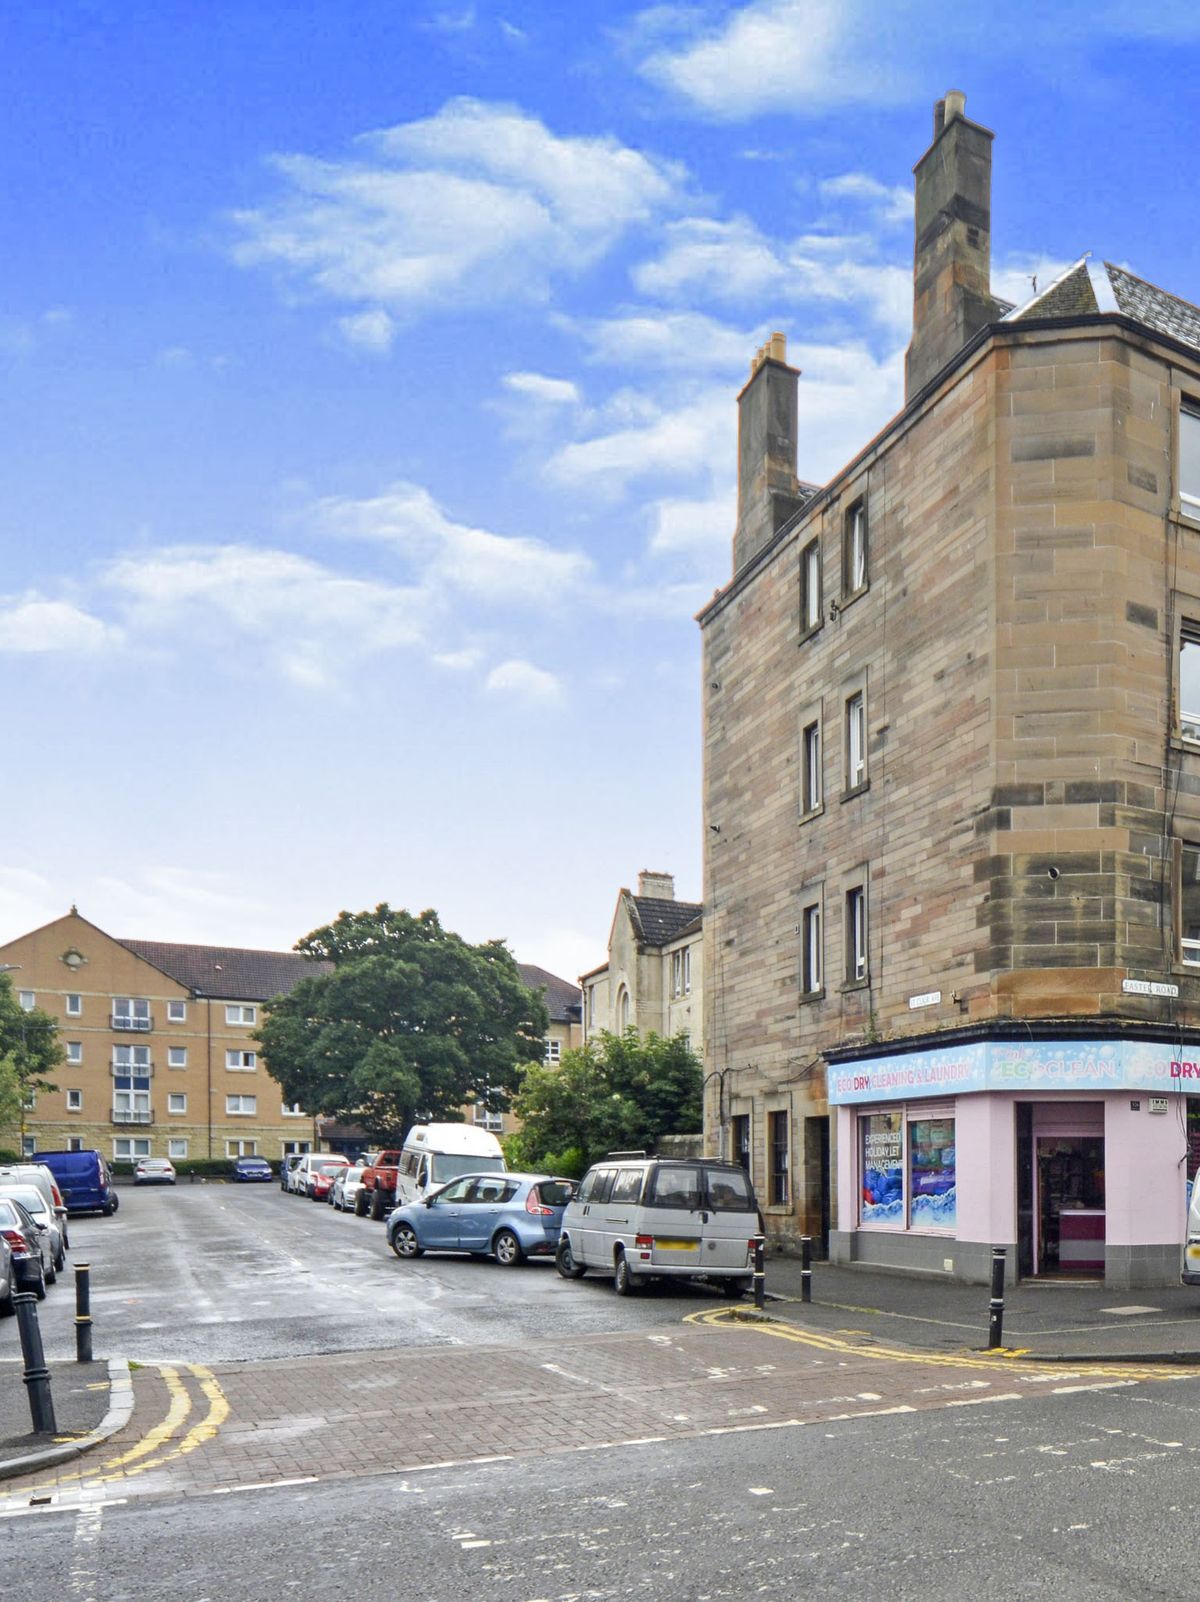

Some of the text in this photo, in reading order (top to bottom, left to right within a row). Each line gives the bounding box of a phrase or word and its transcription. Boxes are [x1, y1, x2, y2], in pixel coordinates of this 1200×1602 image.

[1125, 981, 1177, 995] EASTER ROAD
[837, 1078, 851, 1092] ECO
[854, 1076, 869, 1090] DRY
[872, 1070, 914, 1089] CLEANING
[925, 1063, 971, 1081] LAUNDRY
[865, 1132, 901, 1144] EXPERIENCED
[865, 1145, 900, 1157] HOLIDAY LET
[865, 1159, 903, 1170] MANAGEMENT
